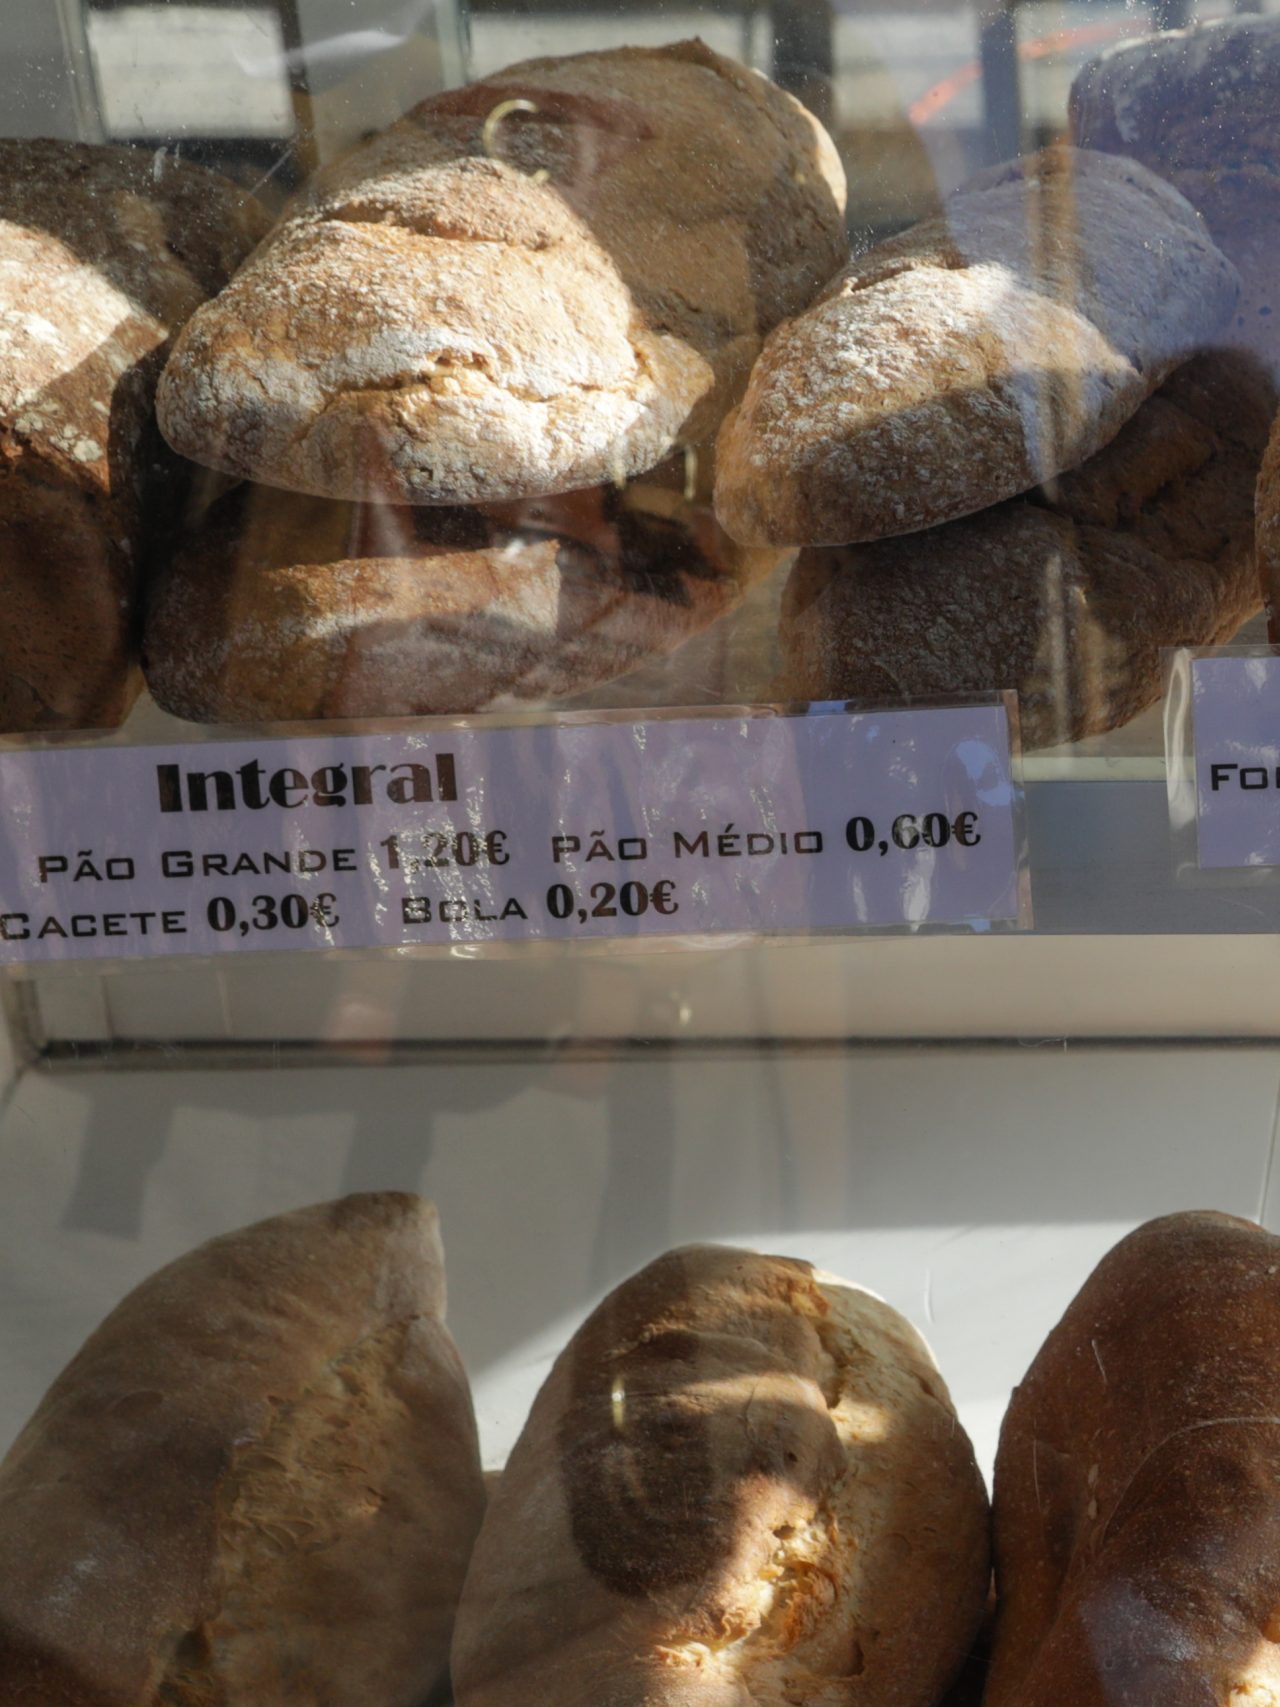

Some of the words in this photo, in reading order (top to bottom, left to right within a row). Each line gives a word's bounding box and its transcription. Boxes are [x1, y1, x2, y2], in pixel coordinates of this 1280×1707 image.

[156, 752, 459, 813] Integral
[38, 850, 136, 884] PÃO
[161, 847, 357, 879] GRANDE
[551, 830, 648, 864] PÃO
[674, 823, 823, 858] MÉDIO
[845, 811, 982, 857] 0,60€
[0, 910, 187, 942] CACETE
[207, 892, 340, 937] 0,30€
[402, 896, 529, 925] BOLA
[546, 880, 679, 924] 0,20€
